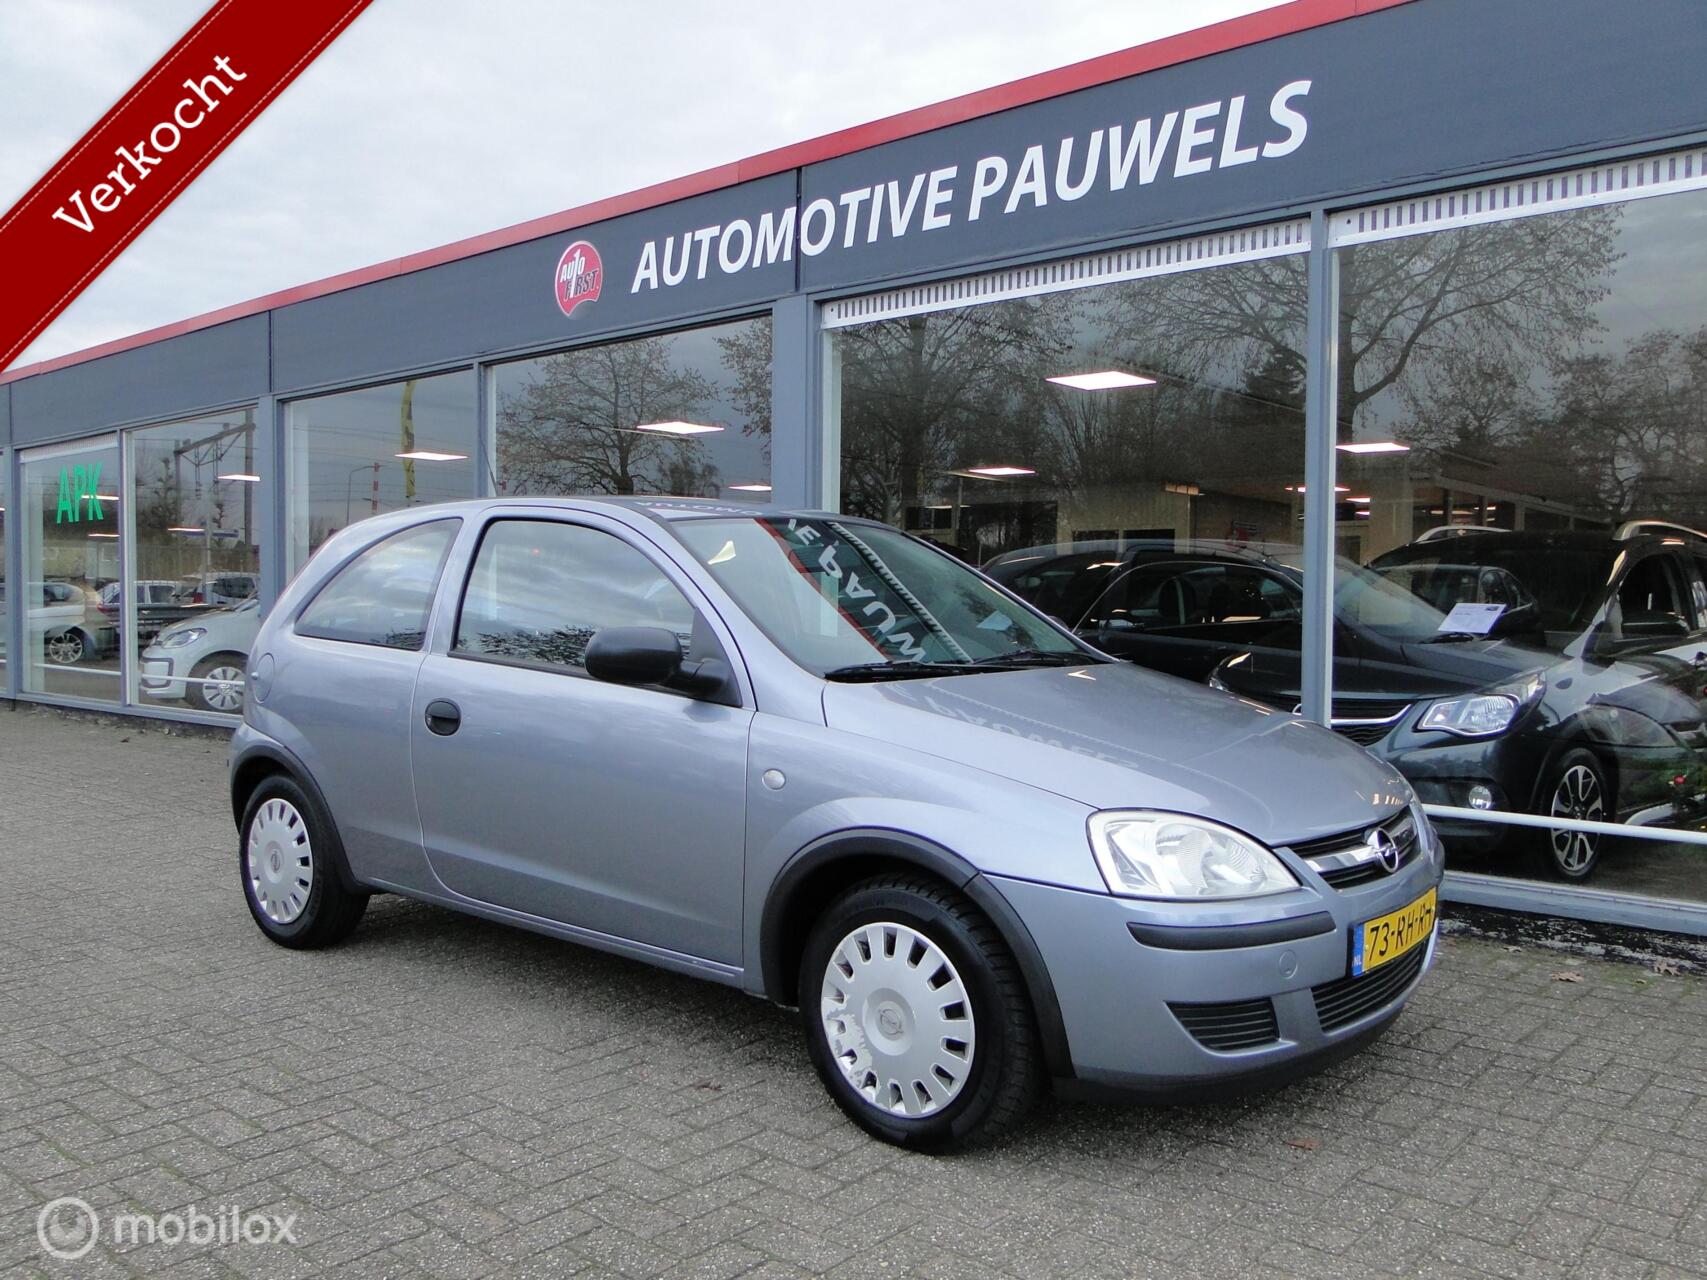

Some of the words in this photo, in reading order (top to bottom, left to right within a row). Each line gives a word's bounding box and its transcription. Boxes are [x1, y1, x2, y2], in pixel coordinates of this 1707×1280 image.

[630, 166, 958, 294] AUTOMOTIVE
[967, 80, 1312, 222] PAUWELS
[57, 464, 103, 523] APK
